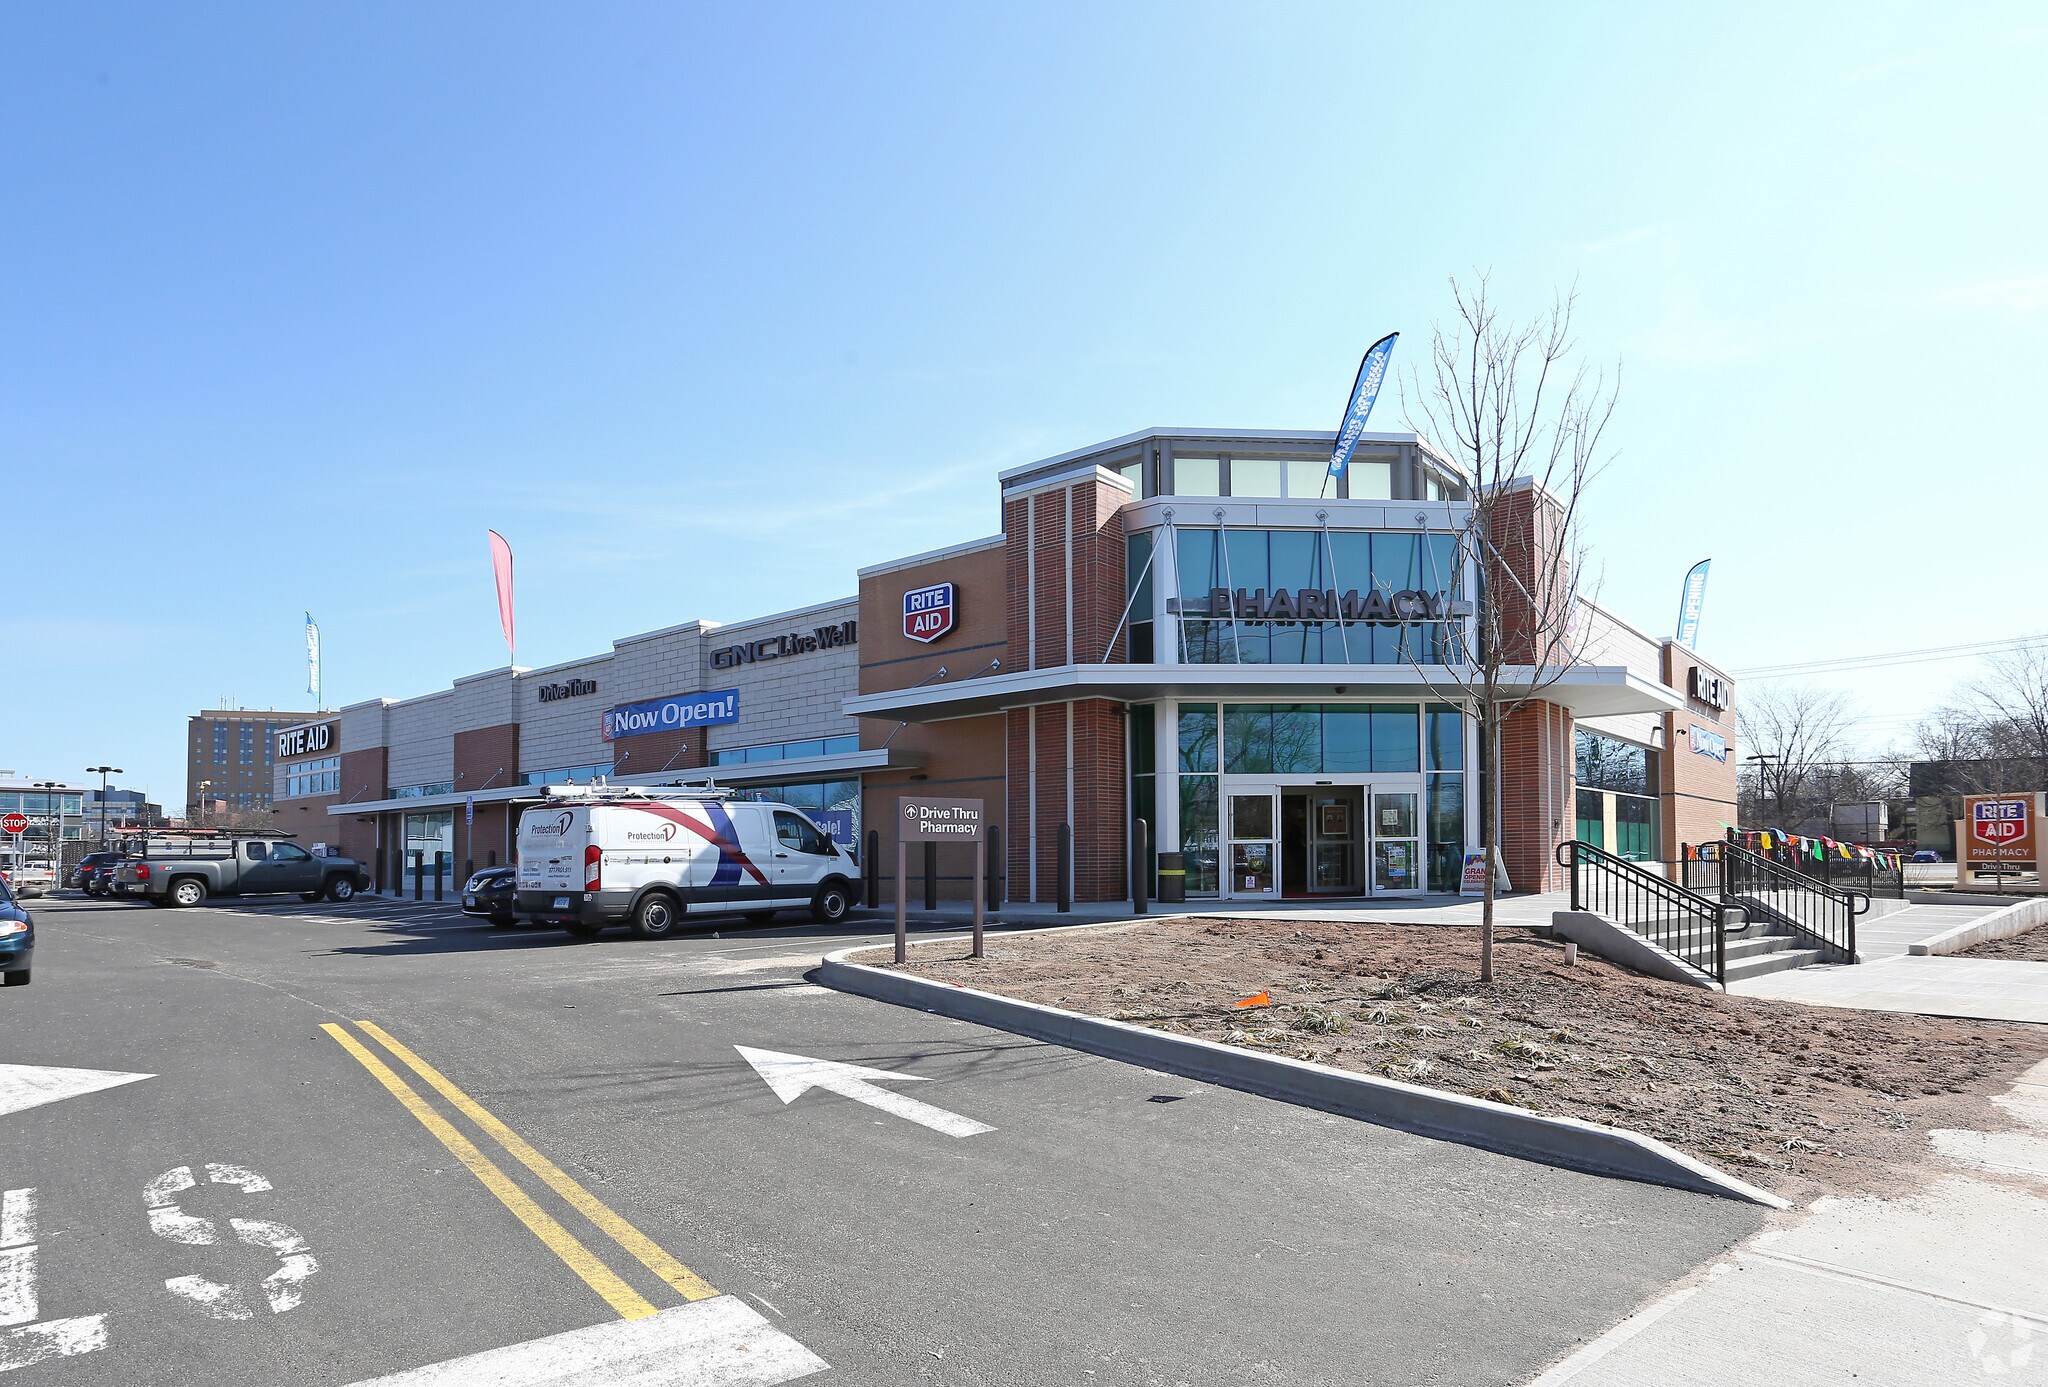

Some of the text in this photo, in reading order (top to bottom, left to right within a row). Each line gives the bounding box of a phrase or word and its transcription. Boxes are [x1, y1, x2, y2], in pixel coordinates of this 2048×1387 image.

[910, 589, 944, 611] RITE
[1210, 587, 1446, 619] PHARMACY
[1684, 573, 1706, 621] OPENING
[913, 612, 942, 633] AID
[710, 620, 857, 669] GNC Live Well
[539, 678, 596, 702] Drive Thru
[1697, 666, 1730, 712] RITE AID
[615, 695, 734, 732] Now Open!
[278, 724, 330, 757] RITE AID
[920, 806, 978, 820] Drive Thru
[1981, 804, 2018, 818] RITE
[3, 819, 26, 828] STOP
[531, 824, 561, 835] Protection
[920, 820, 978, 836] Pharmacy
[1984, 822, 2016, 837] AID
[627, 831, 665, 840] Protection
[1464, 867, 1486, 875] GRAN
